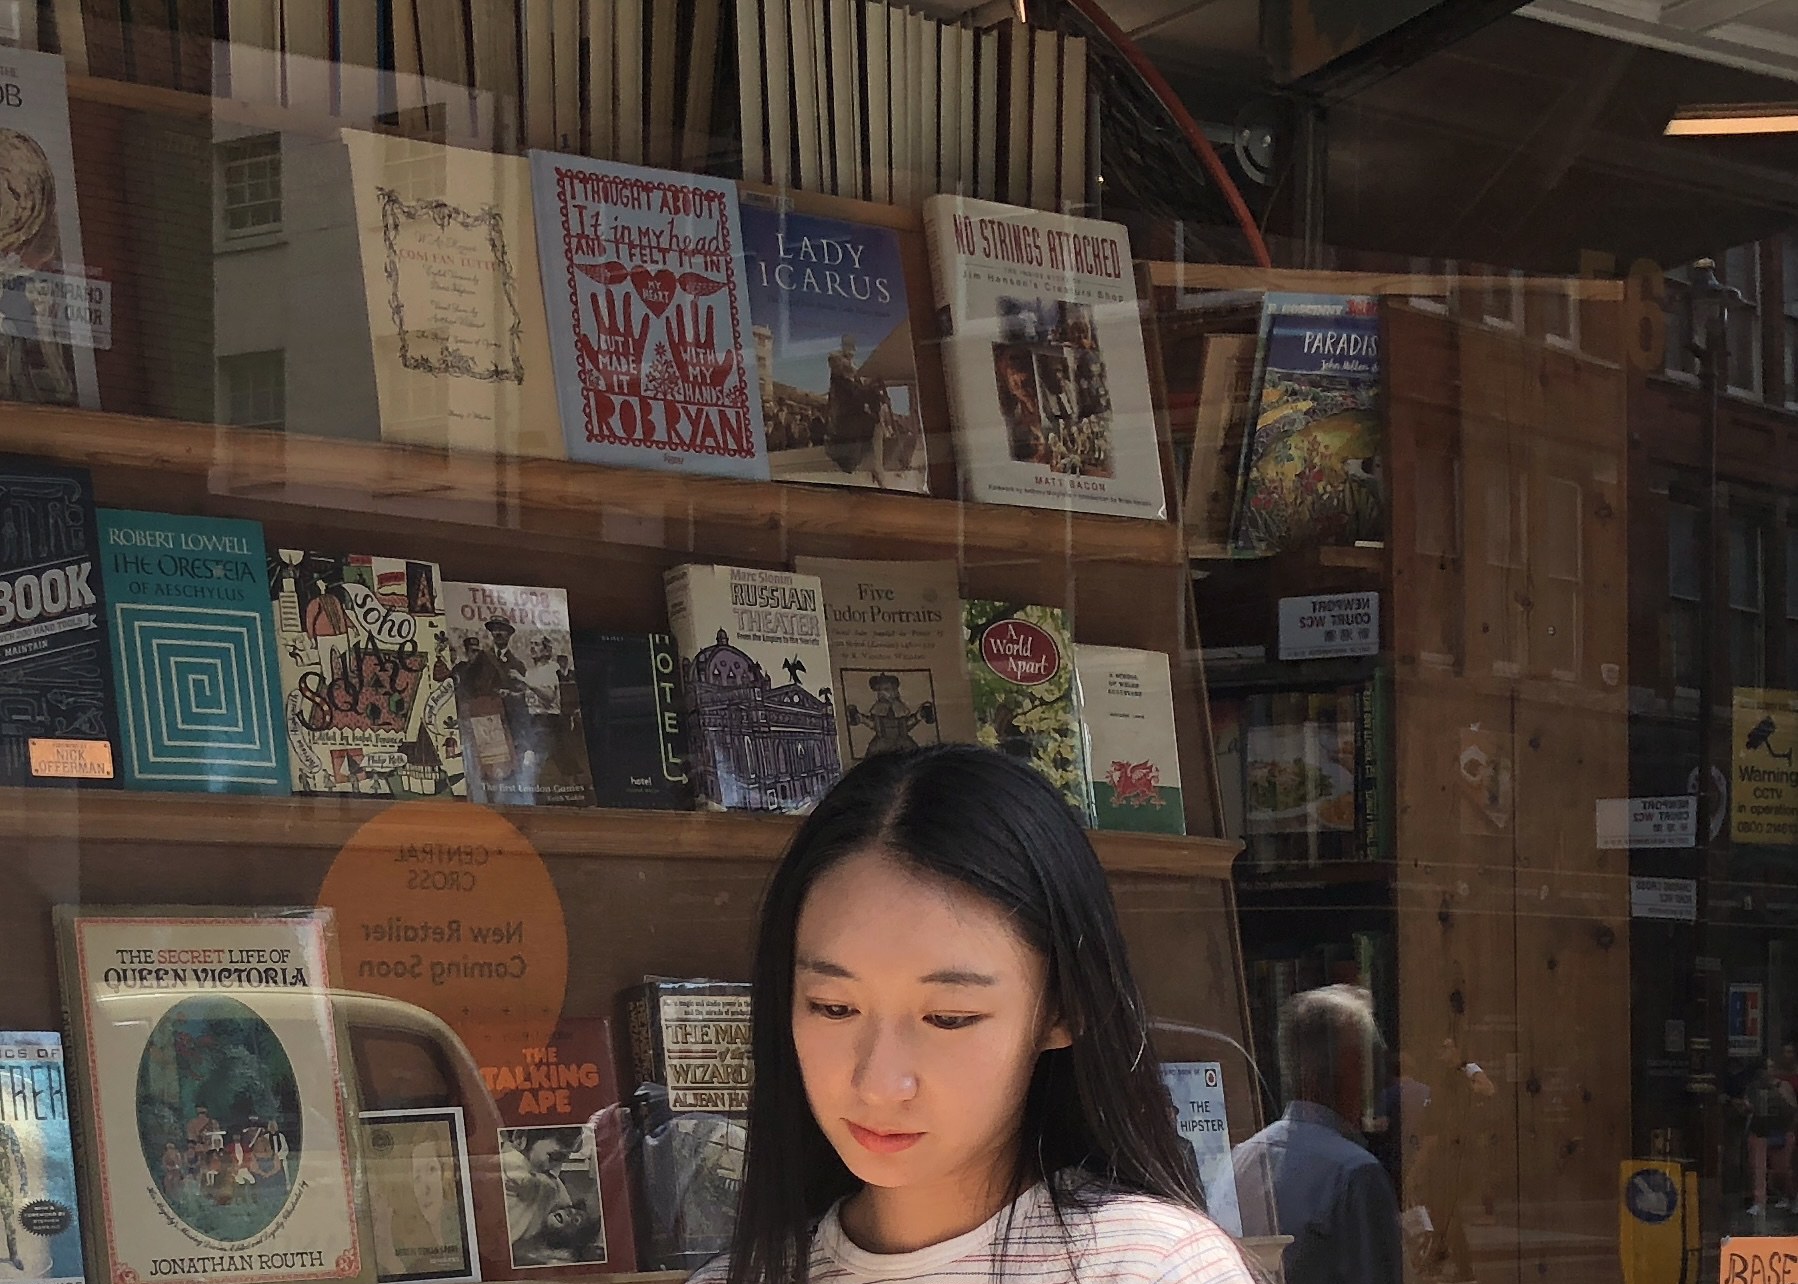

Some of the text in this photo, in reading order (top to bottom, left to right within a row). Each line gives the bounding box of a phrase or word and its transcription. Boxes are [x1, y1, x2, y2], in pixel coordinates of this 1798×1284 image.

[577, 178, 718, 218] THOUGHT ABOUT
[668, 218, 721, 256] head
[953, 214, 976, 256] NO
[979, 218, 1044, 267] STRINGS
[1047, 229, 1122, 279] ATTACHED
[776, 233, 864, 268] LADY
[759, 261, 890, 303] ICARUS
[598, 354, 638, 374] MADE
[682, 345, 716, 366] WITH
[612, 375, 631, 394] IT
[688, 365, 714, 384] MY
[588, 391, 748, 451] ROB RYAN
[1034, 475, 1106, 492] MATT BACON
[108, 527, 253, 555] ROBERT LOWELL
[113, 552, 257, 584] THE ORESTEIA
[731, 569, 758, 583] Marc
[128, 581, 246, 602] OF AESCHYLUS
[468, 587, 507, 607] THE
[731, 582, 817, 612] RUSSIAN
[857, 583, 895, 601] Five
[461, 604, 561, 626] OLYMPICS
[732, 607, 821, 638] THEATER
[822, 602, 943, 624] Tudor Portraits
[1007, 624, 1018, 640] A
[4, 639, 49, 658] MAINTAIN
[989, 635, 1033, 658] World
[1007, 654, 1049, 681] Apart
[55, 748, 86, 761] NICK
[38, 759, 107, 776] OFFERMAN
[1739, 765, 1798, 787] Warning
[554, 783, 586, 794] Games
[630, 776, 653, 787] hotel
[1753, 788, 1783, 799] CCTV
[1751, 804, 1798, 818] operation
[115, 949, 291, 965] THE SECRET LIFE OF
[104, 967, 309, 993] QUEEN VICTORIA
[665, 1023, 712, 1045] THE
[522, 1046, 558, 1064] THE
[479, 1062, 600, 1091] TALKING
[668, 1063, 750, 1086] WIZARD
[517, 1088, 572, 1115] APE
[673, 1091, 725, 1109] ALJEAN
[1189, 1101, 1211, 1114] THE
[1180, 1119, 1225, 1132] HIPSTER
[150, 1250, 325, 1276] JONATHAN ROUTH
